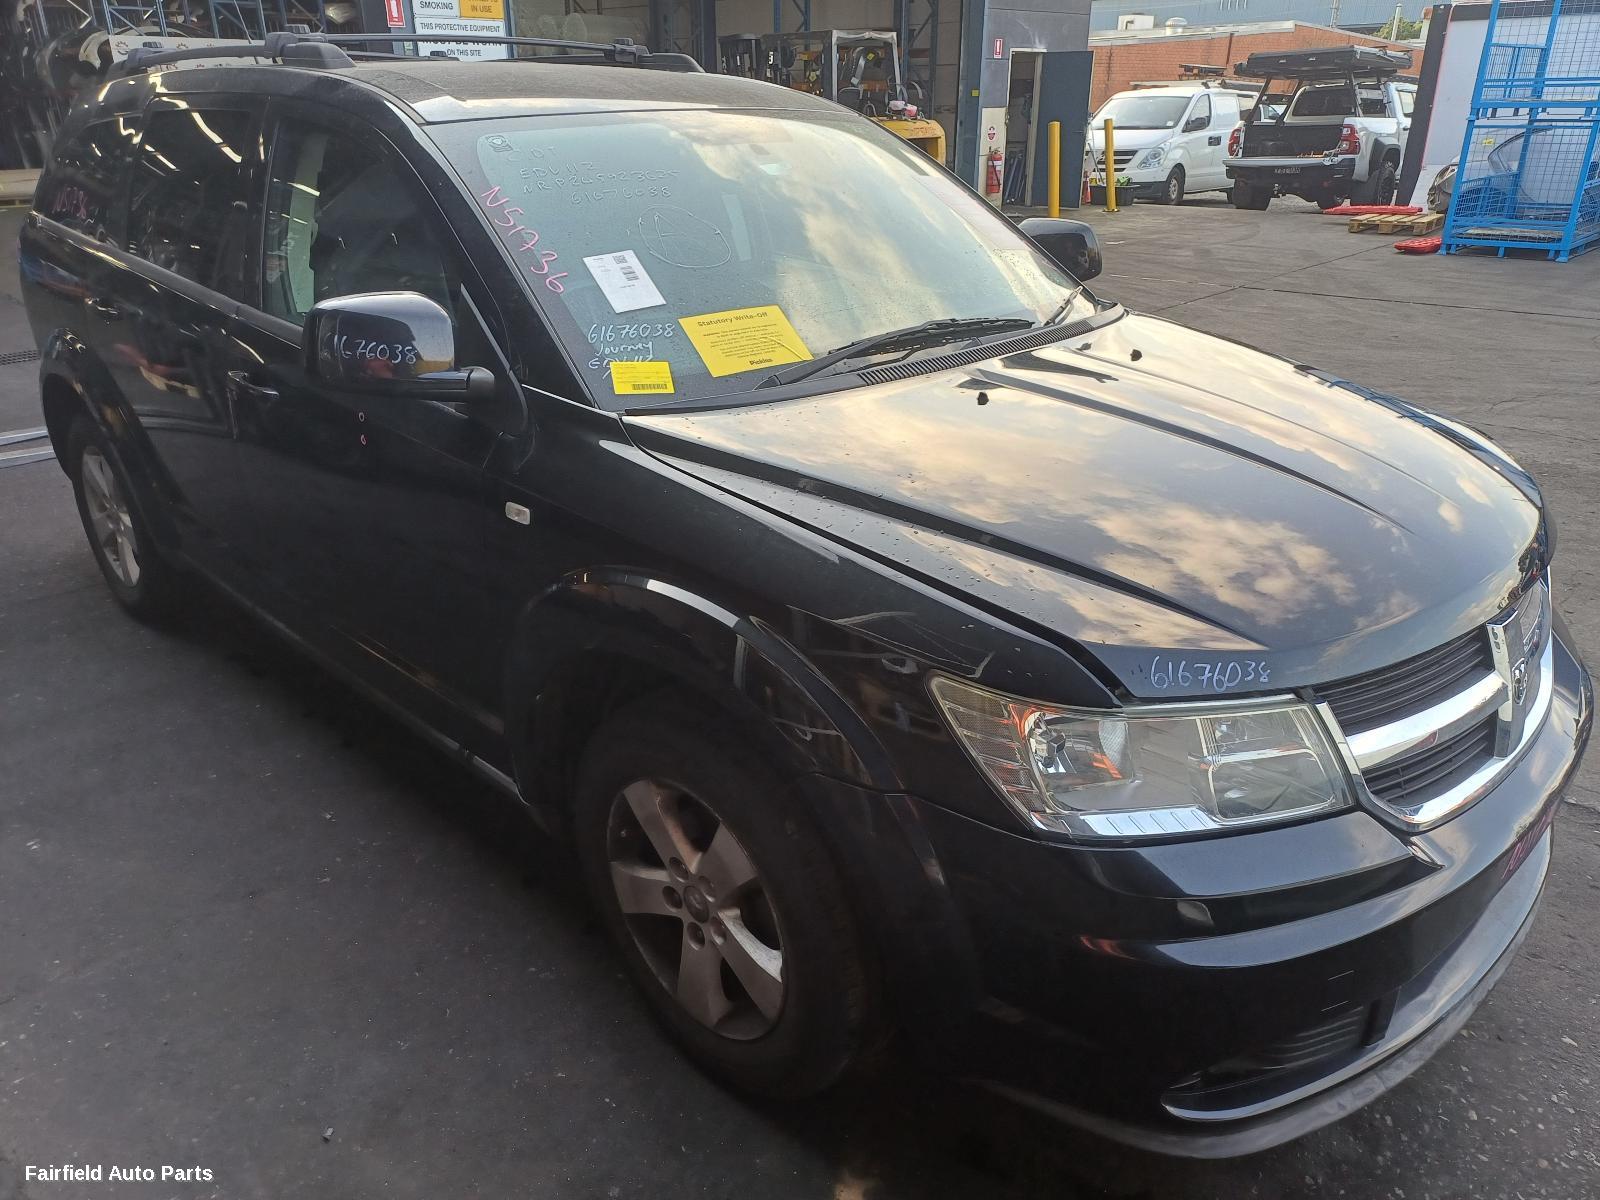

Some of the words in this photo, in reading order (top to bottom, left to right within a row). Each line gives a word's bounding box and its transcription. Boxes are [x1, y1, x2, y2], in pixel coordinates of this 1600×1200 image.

[420, 1, 453, 10] SMOKING
[471, 4, 478, 12] IN
[480, 5, 492, 13] USE
[420, 22, 434, 31] THIS
[434, 23, 469, 32] PROTECTIVE
[469, 24, 500, 33] EQUIPMENT
[447, 48, 455, 56] ON
[457, 49, 468, 57] THIS
[469, 49, 482, 57] SITE
[697, 316, 733, 327] Statutory
[587, 323, 676, 344] 61676038
[595, 341, 653, 359] Journey
[1150, 655, 1271, 692] 61676038
